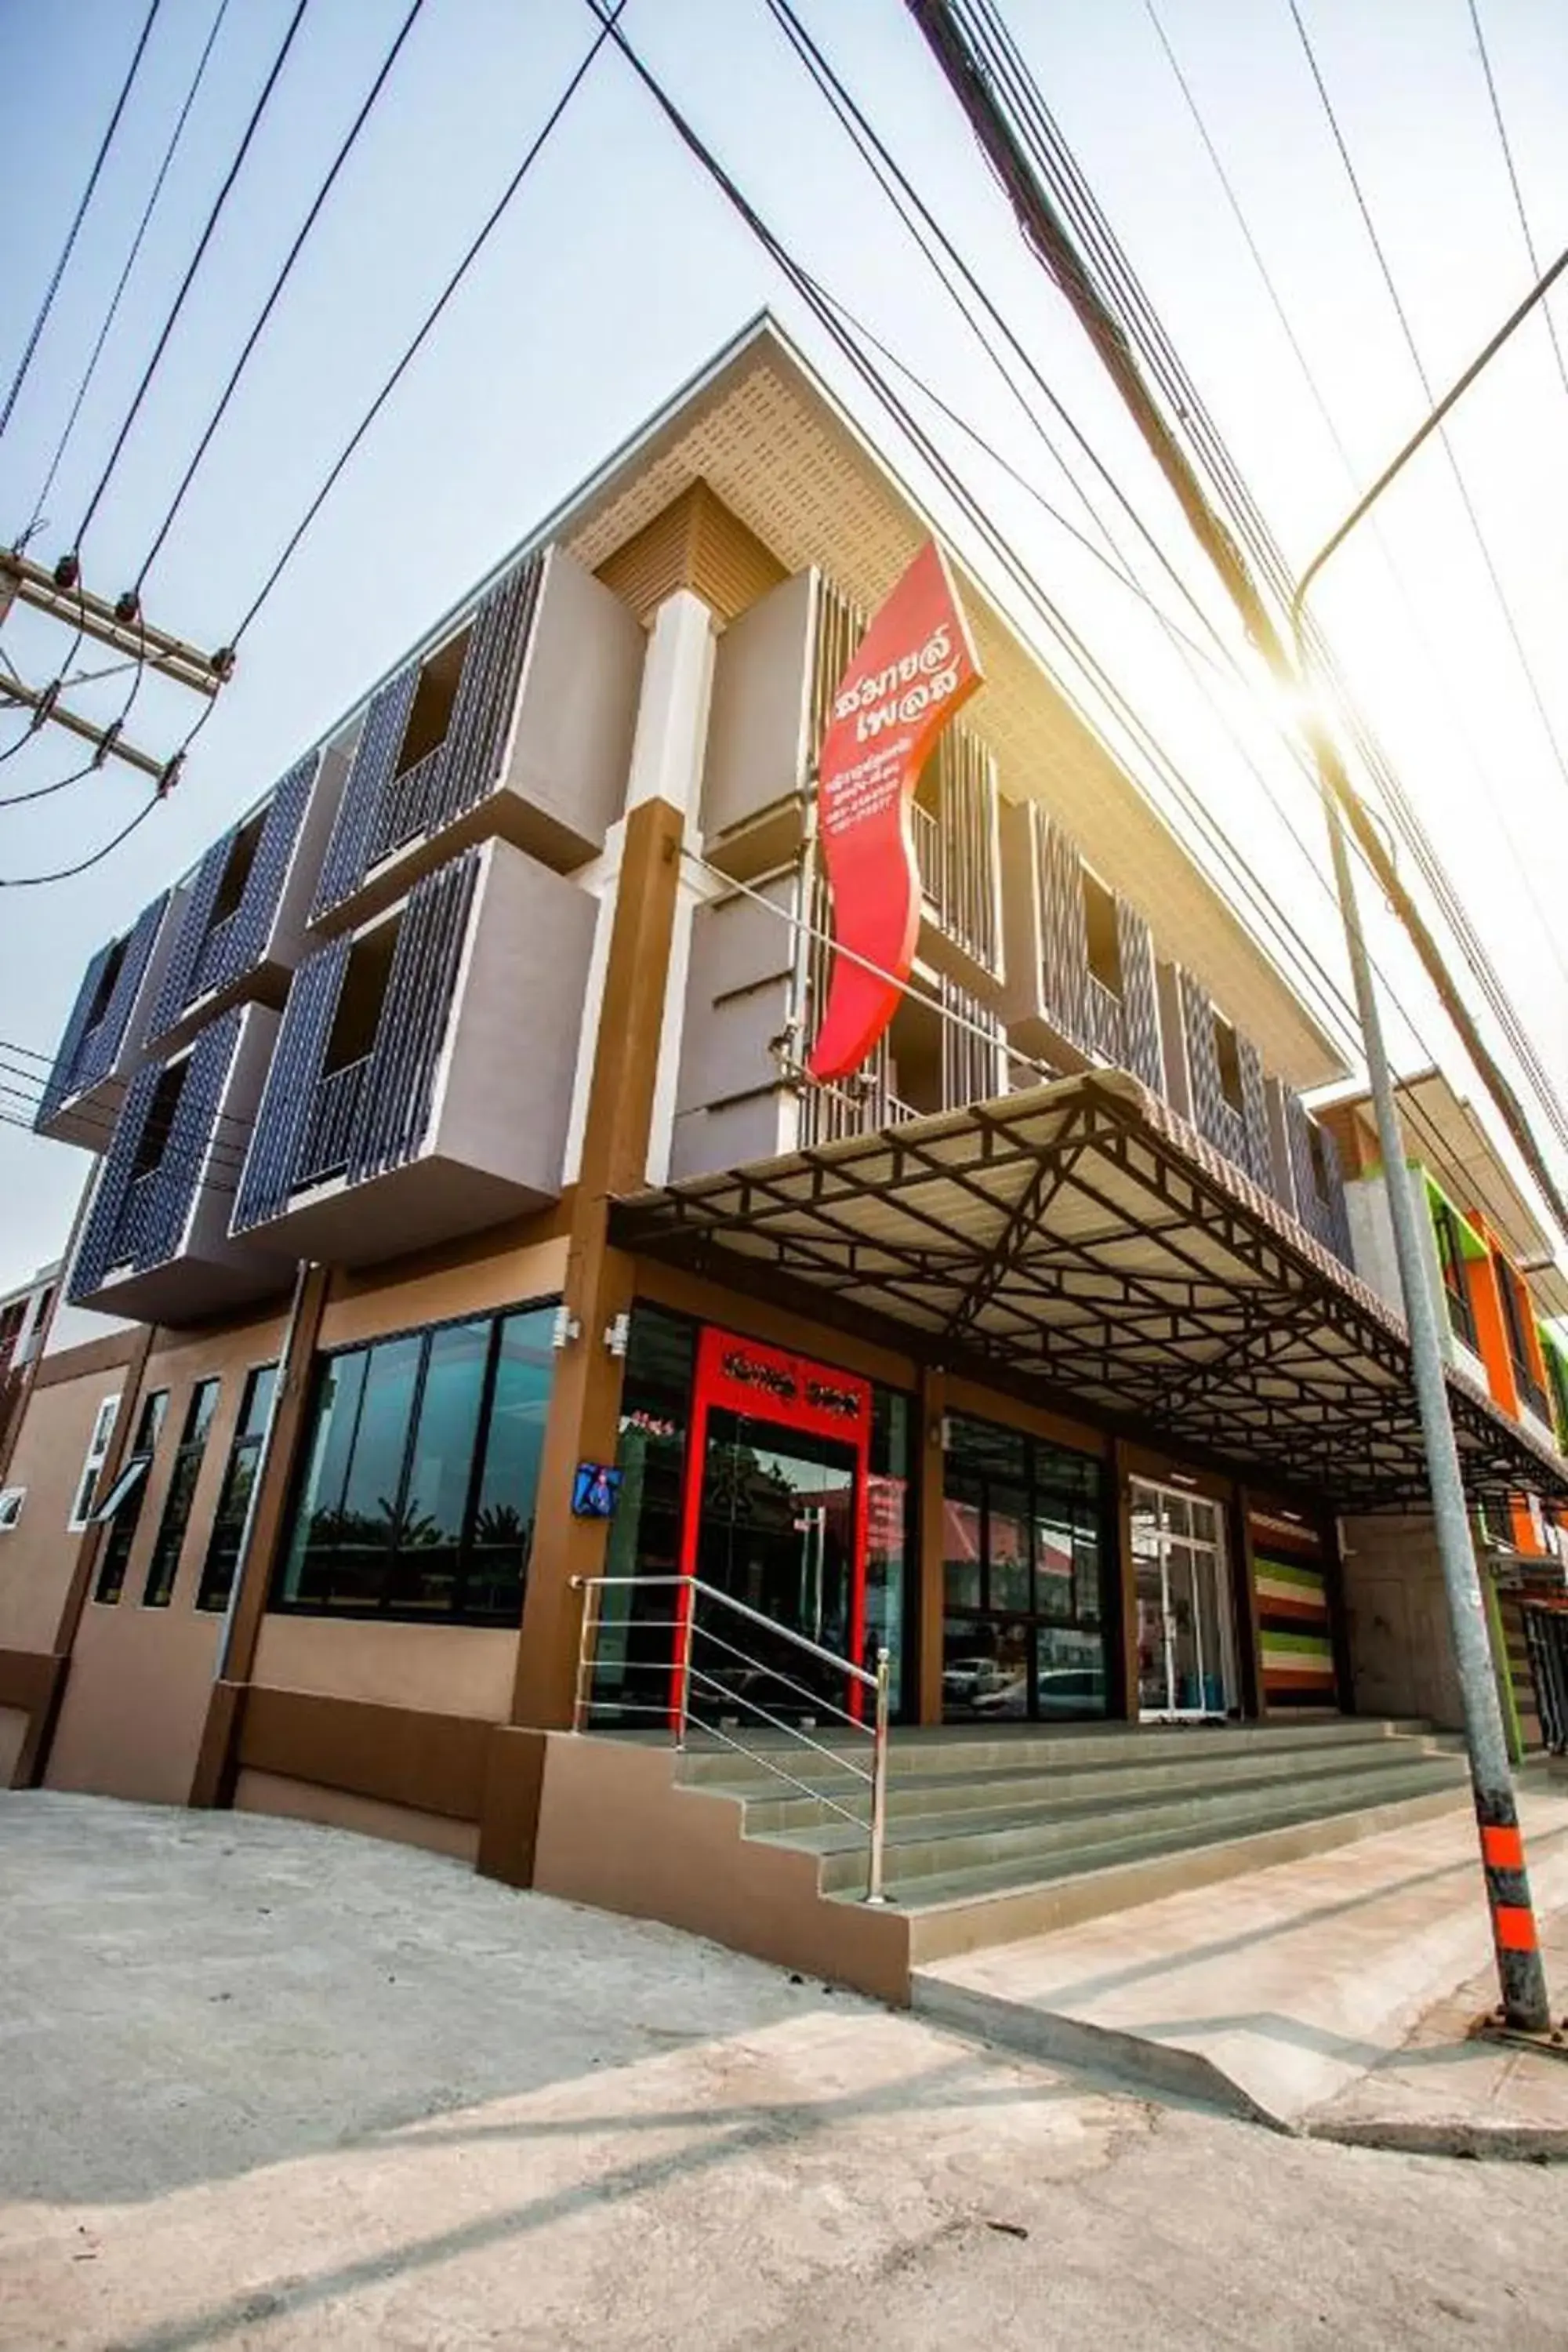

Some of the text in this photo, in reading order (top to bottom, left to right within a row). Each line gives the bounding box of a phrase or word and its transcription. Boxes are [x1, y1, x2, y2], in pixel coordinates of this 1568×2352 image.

[834, 622, 951, 719] สมายล์
[856, 652, 962, 742] เพลส
